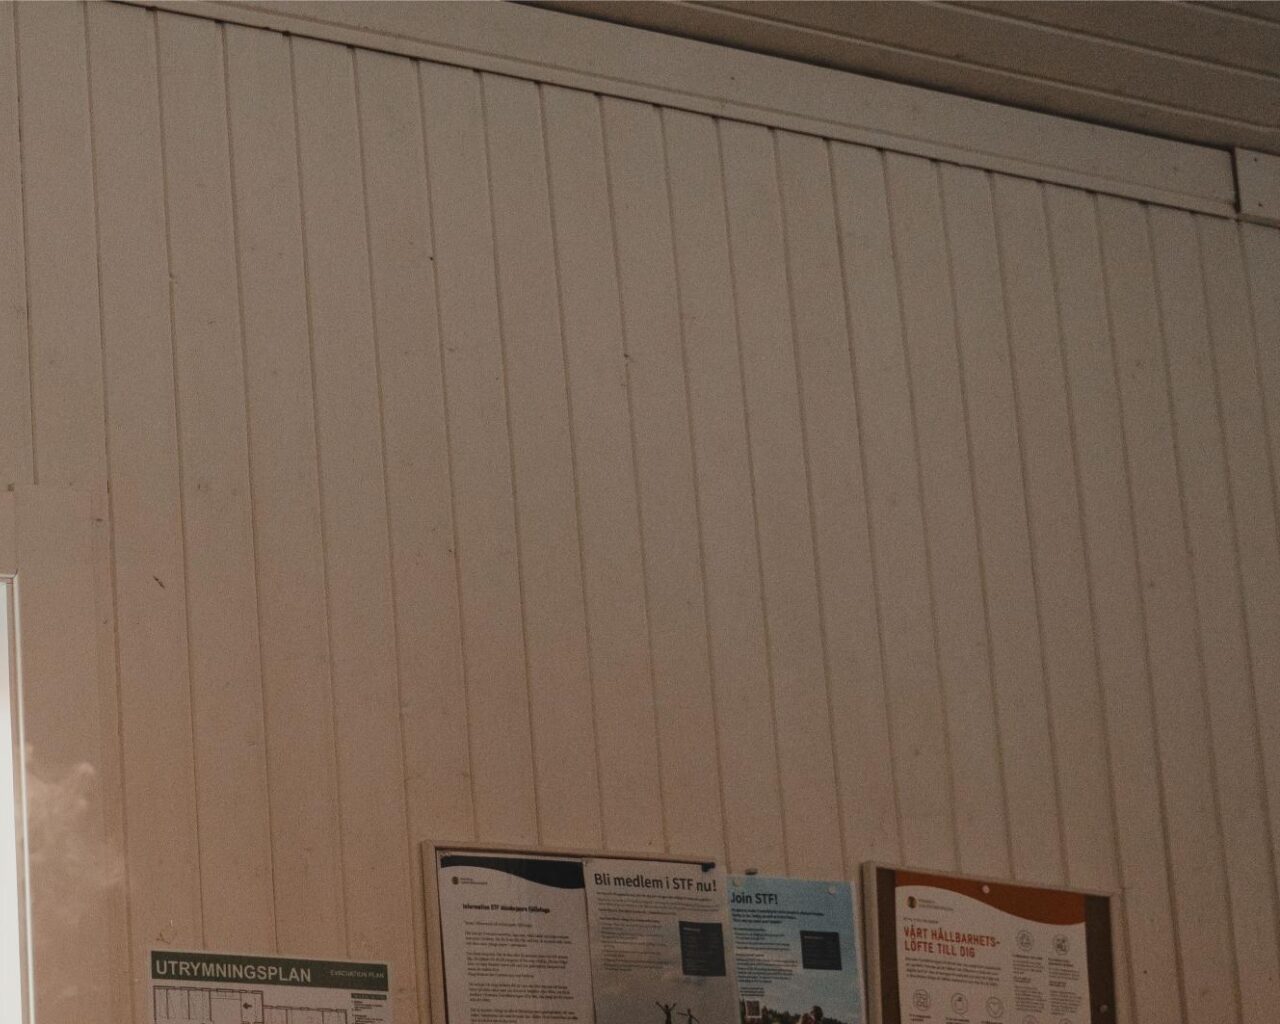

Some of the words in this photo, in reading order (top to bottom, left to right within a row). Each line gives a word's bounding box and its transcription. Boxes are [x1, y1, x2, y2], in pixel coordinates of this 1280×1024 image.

[594, 873, 610, 886] Bli
[614, 874, 663, 889] medlem
[672, 877, 693, 890] STF
[697, 879, 717, 892] nu!
[731, 892, 752, 904] Join
[755, 893, 778, 905] STF!
[904, 925, 928, 938] VÅRT
[931, 928, 1000, 947] HÅLLBARHETS-
[904, 940, 934, 953] LÖFTE
[937, 943, 957, 956] TILL
[960, 946, 976, 958] DIG
[155, 959, 312, 983] UTRYMNINGSPLAN
